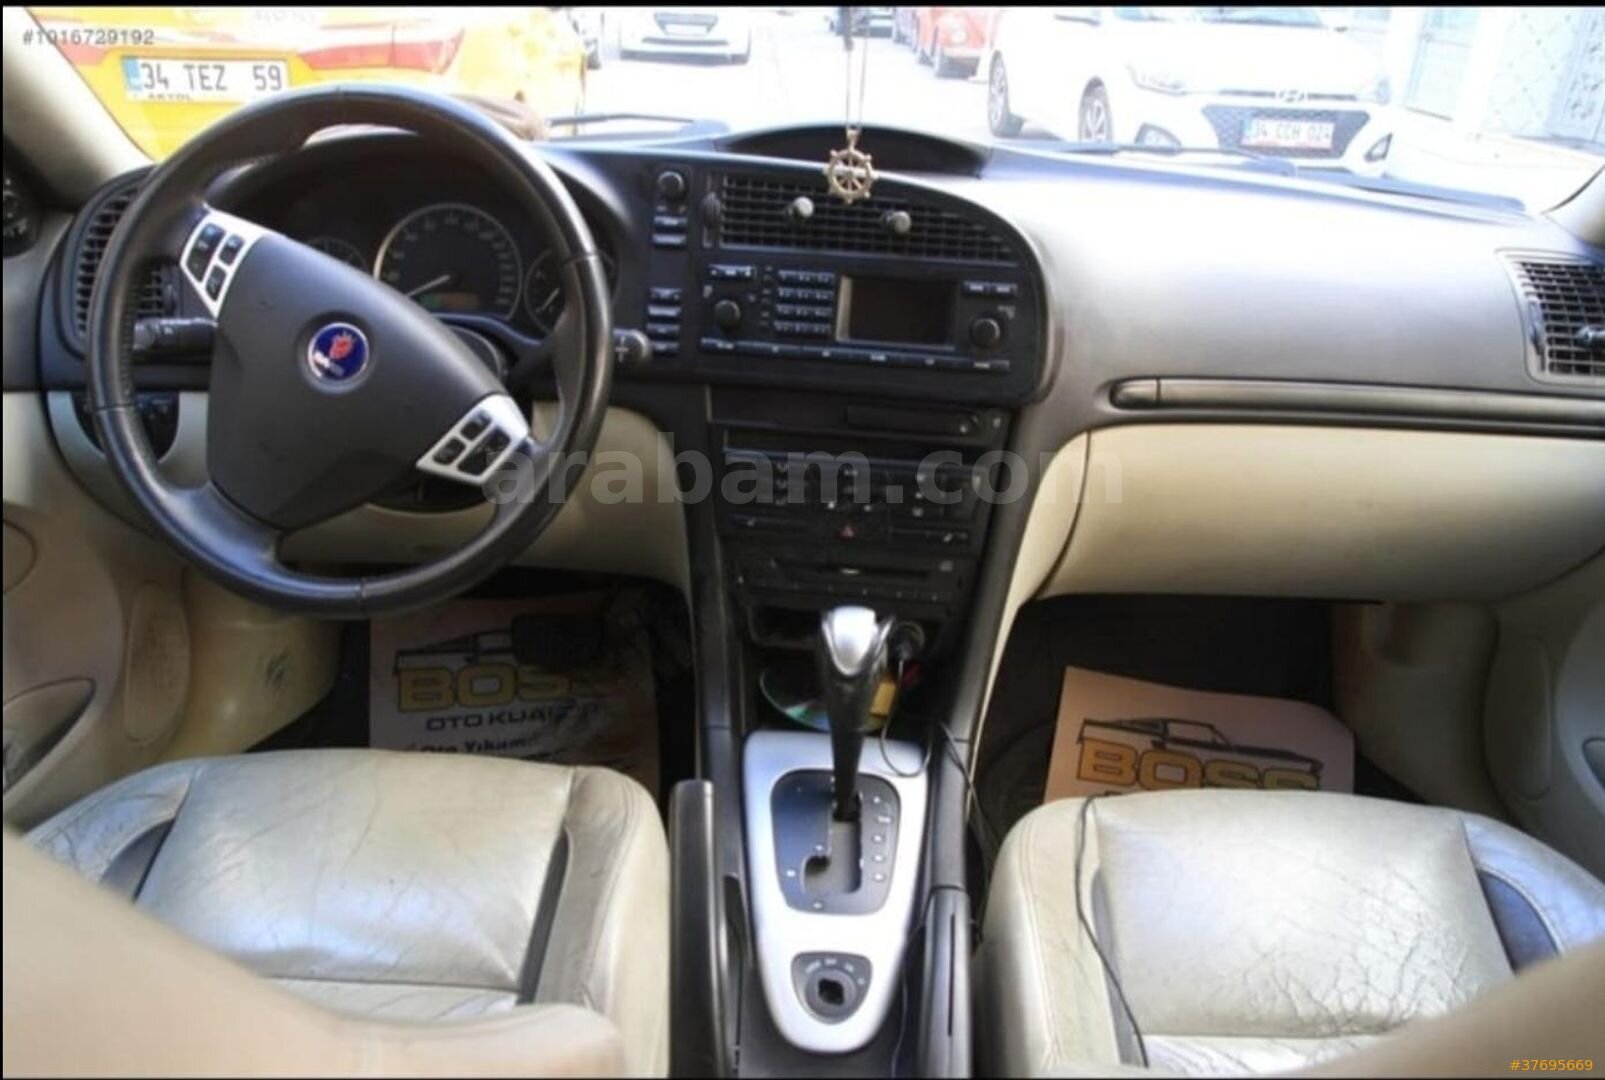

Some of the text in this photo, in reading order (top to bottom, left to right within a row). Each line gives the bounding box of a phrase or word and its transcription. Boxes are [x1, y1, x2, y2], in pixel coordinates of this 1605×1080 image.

[140, 62, 283, 92] 34 TEZ 59
[397, 662, 608, 713] BOS
[426, 711, 482, 731] OTO
